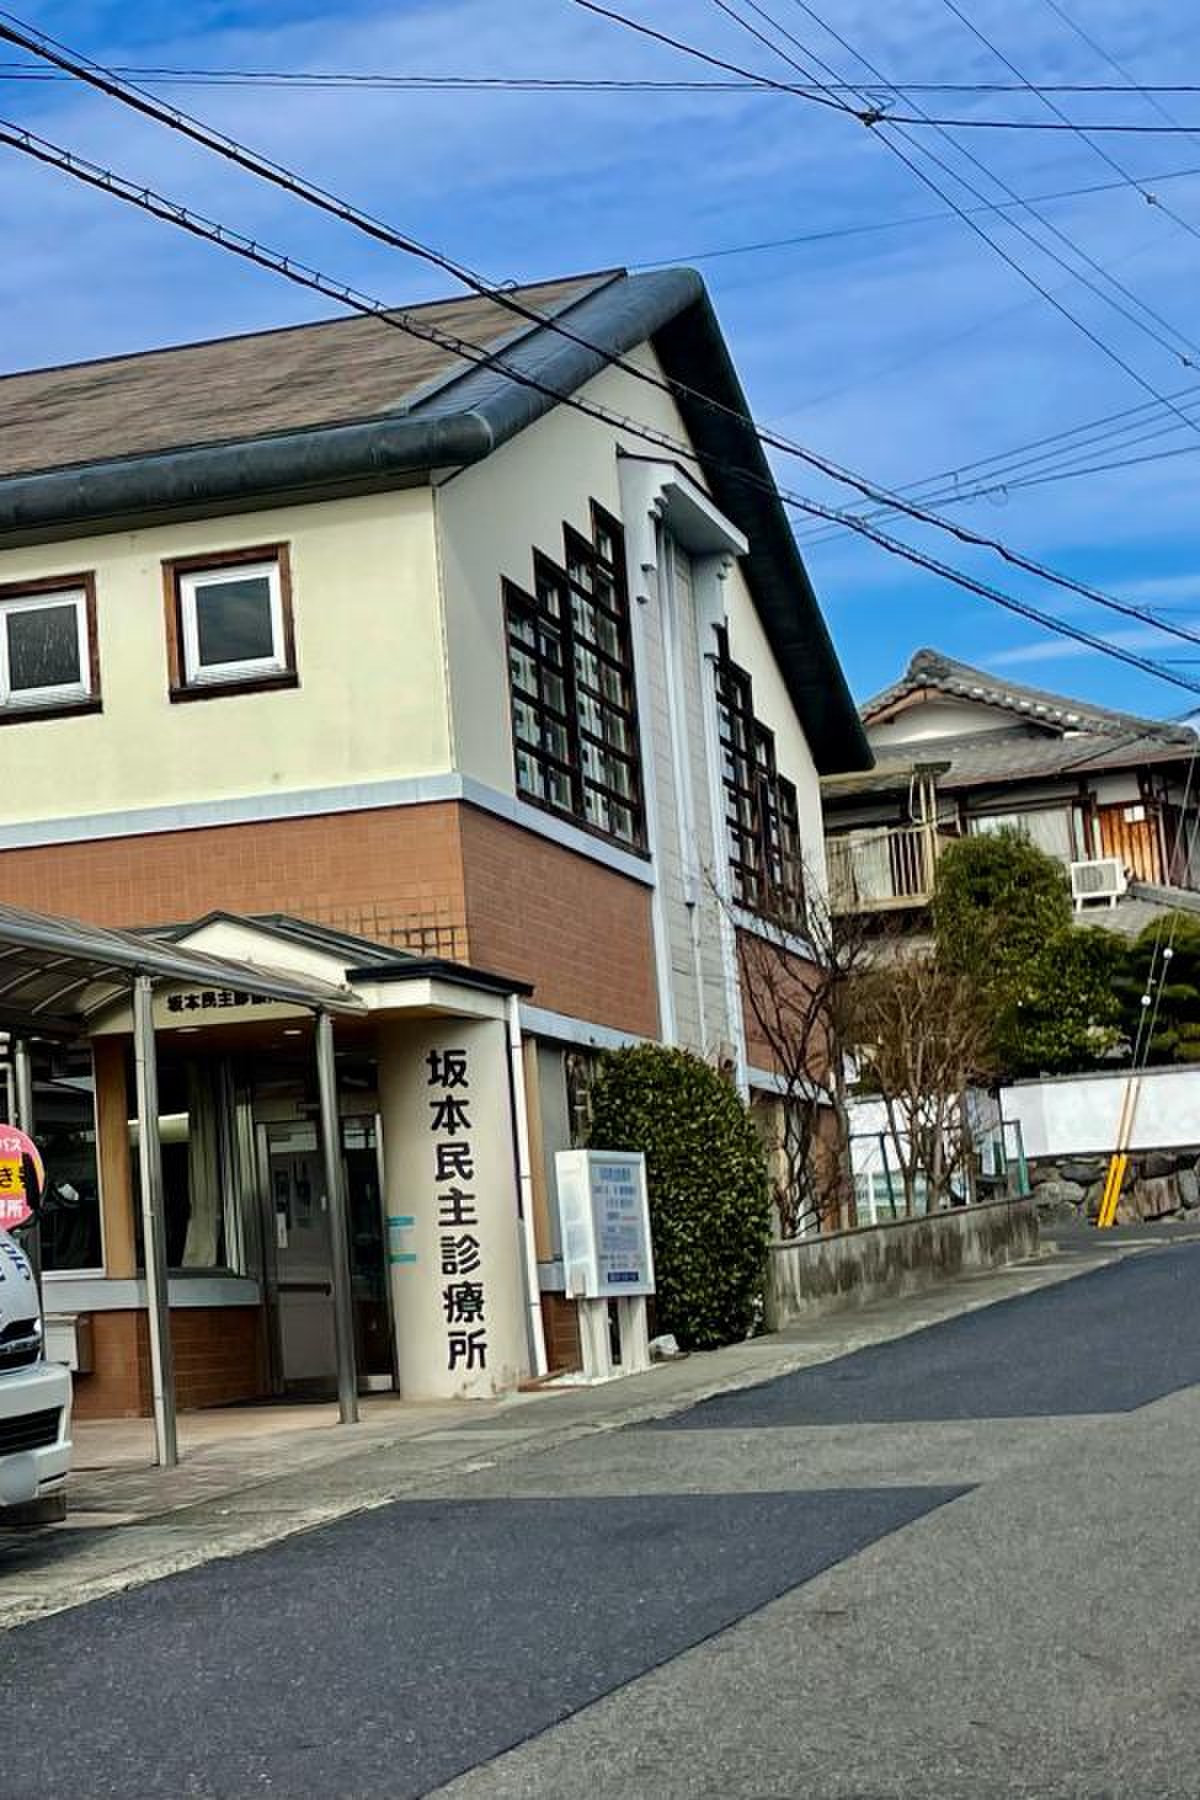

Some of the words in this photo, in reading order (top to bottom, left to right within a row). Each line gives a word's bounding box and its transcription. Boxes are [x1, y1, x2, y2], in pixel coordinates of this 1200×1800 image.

[425, 1049, 487, 1371] 坂本民主診療所
